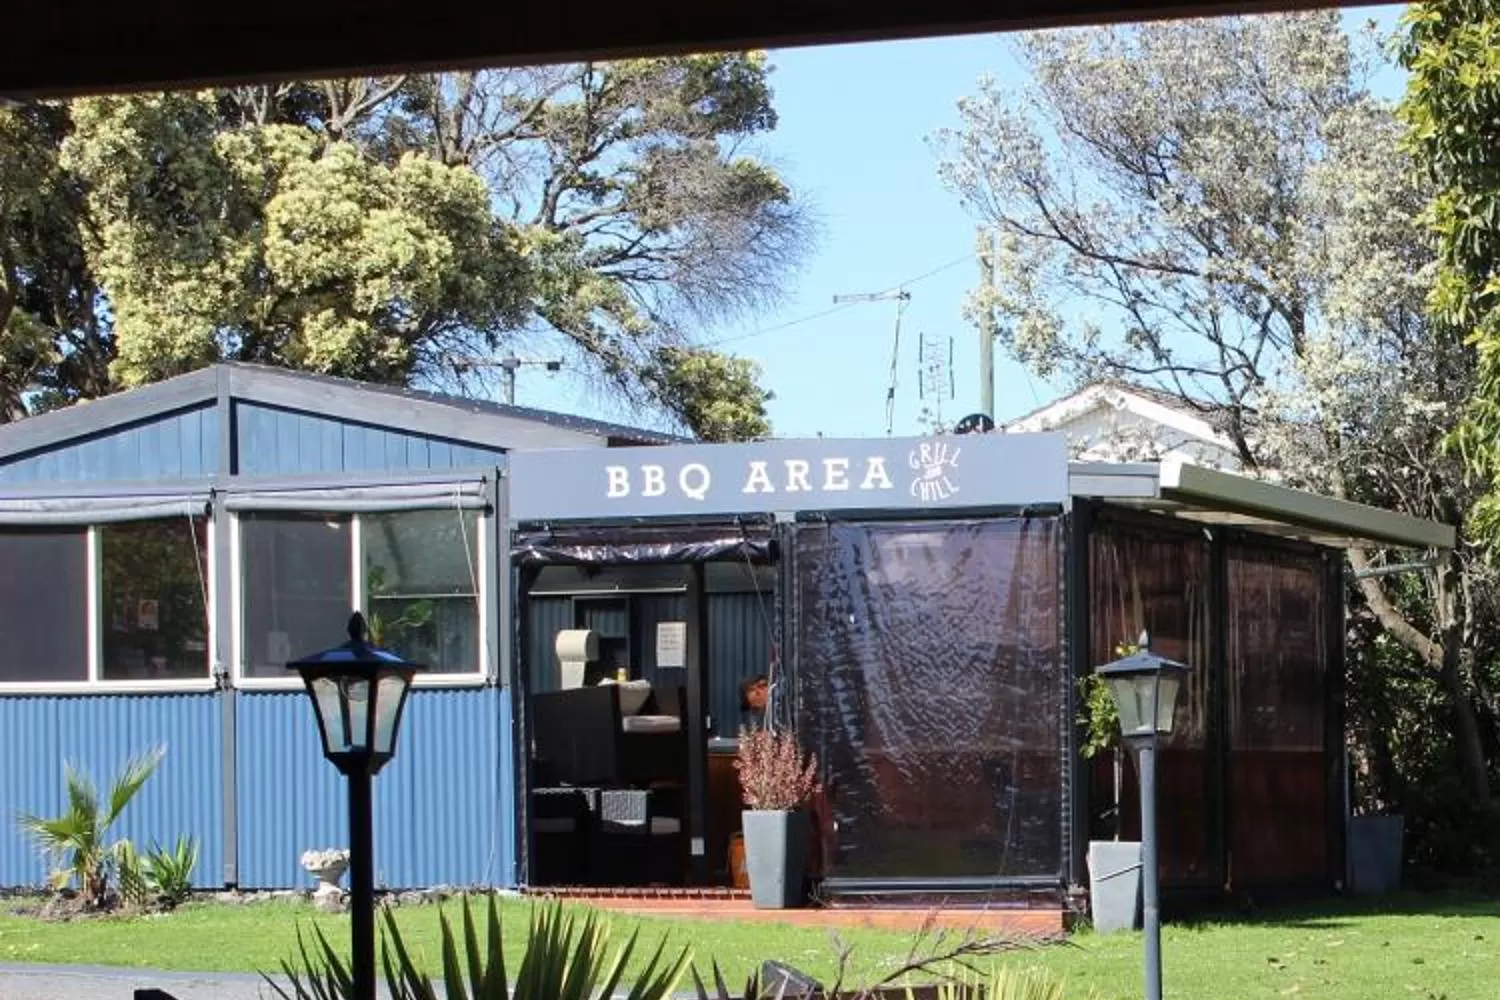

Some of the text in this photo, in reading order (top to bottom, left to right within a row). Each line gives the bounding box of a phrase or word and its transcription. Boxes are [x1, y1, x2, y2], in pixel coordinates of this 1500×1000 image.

[909, 442, 961, 469] GRILL
[605, 463, 710, 500] BBQ
[741, 456, 894, 493] AREA
[910, 476, 961, 501] CHILL
